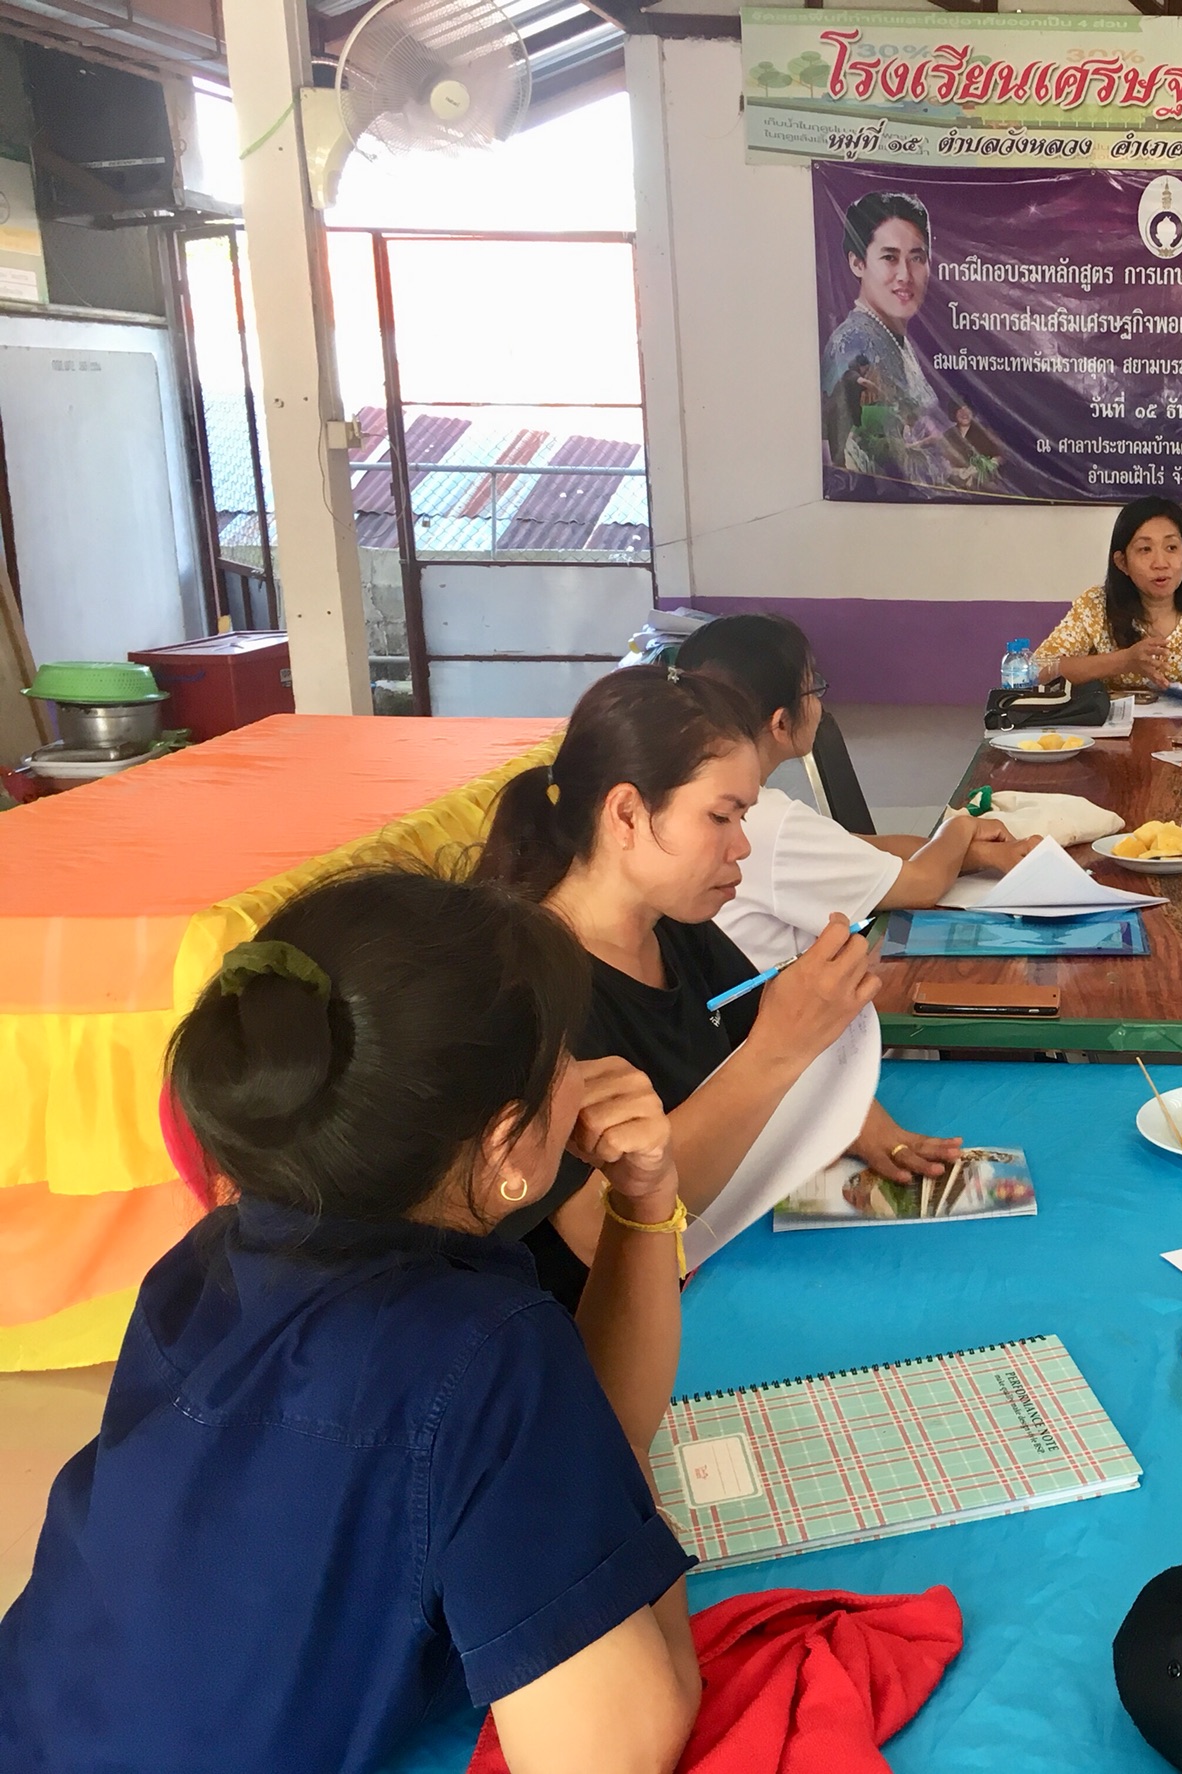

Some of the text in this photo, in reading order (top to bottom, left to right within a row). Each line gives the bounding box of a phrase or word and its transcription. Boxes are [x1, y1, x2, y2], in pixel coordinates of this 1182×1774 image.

[828, 120, 885, 159] หมู่ที่
[888, 138, 922, 152] ๑๕
[938, 129, 1093, 157] ตำบลวังหลวง
[938, 255, 1114, 292] การฝึกอบรมหลักสูตร
[933, 348, 1115, 380] สมเด็จพระเทพรัตนราชสุดา
[1090, 392, 1126, 419] วันที่
[1135, 404, 1157, 419] ๑๕
[1036, 438, 1051, 453] ณ
[1088, 464, 1165, 486] อำเภอเฝ้าไร่
[1005, 1371, 1060, 1452] PERFORMANCE NOTE
